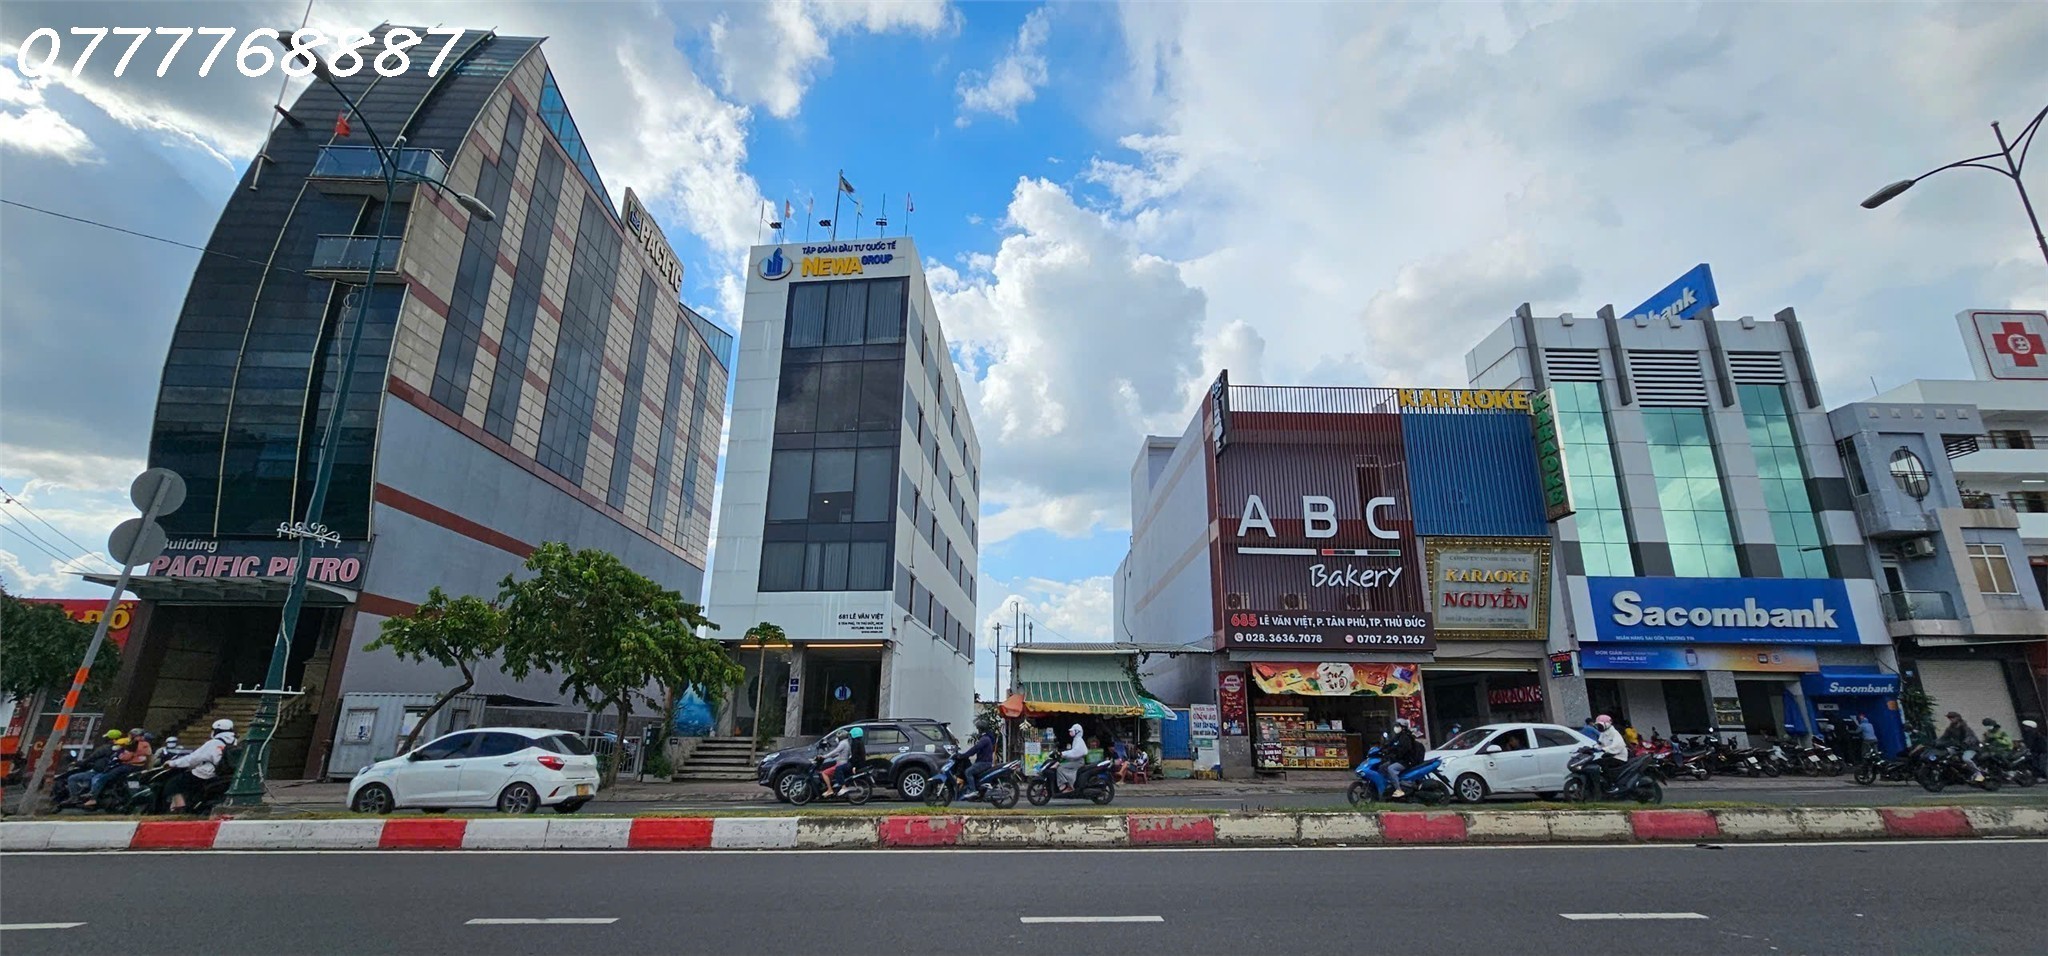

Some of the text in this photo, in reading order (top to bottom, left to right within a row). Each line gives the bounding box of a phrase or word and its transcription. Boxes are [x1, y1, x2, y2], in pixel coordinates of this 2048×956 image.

[639, 217, 682, 293] PACIFIC
[866, 241, 886, 251] QUỐC
[887, 240, 897, 250] TẾ
[802, 256, 864, 278] NEWA
[861, 254, 894, 266] GROUP
[1399, 388, 1529, 410] KARAOKE
[1532, 394, 1564, 508] KARAOKE
[149, 555, 261, 578] PACIFIC
[1445, 568, 1531, 585] KARAOKE
[1443, 587, 1530, 610] NGUYỄN
[1612, 590, 1839, 628] Sacombank
[1230, 613, 1258, 627] 685
[1259, 615, 1270, 626] LÊ
[1272, 615, 1291, 626] VĂN
[1293, 616, 1315, 630] VIỆT,
[1317, 618, 1325, 627] P.
[1326, 616, 1345, 627] TÂN
[1384, 615, 1402, 628] THỦ
[1404, 615, 1426, 628] ĐỨC
[1245, 633, 1426, 645] 028.3636.7078 0707.29.1267
[1829, 682, 1895, 693] Sacombank
